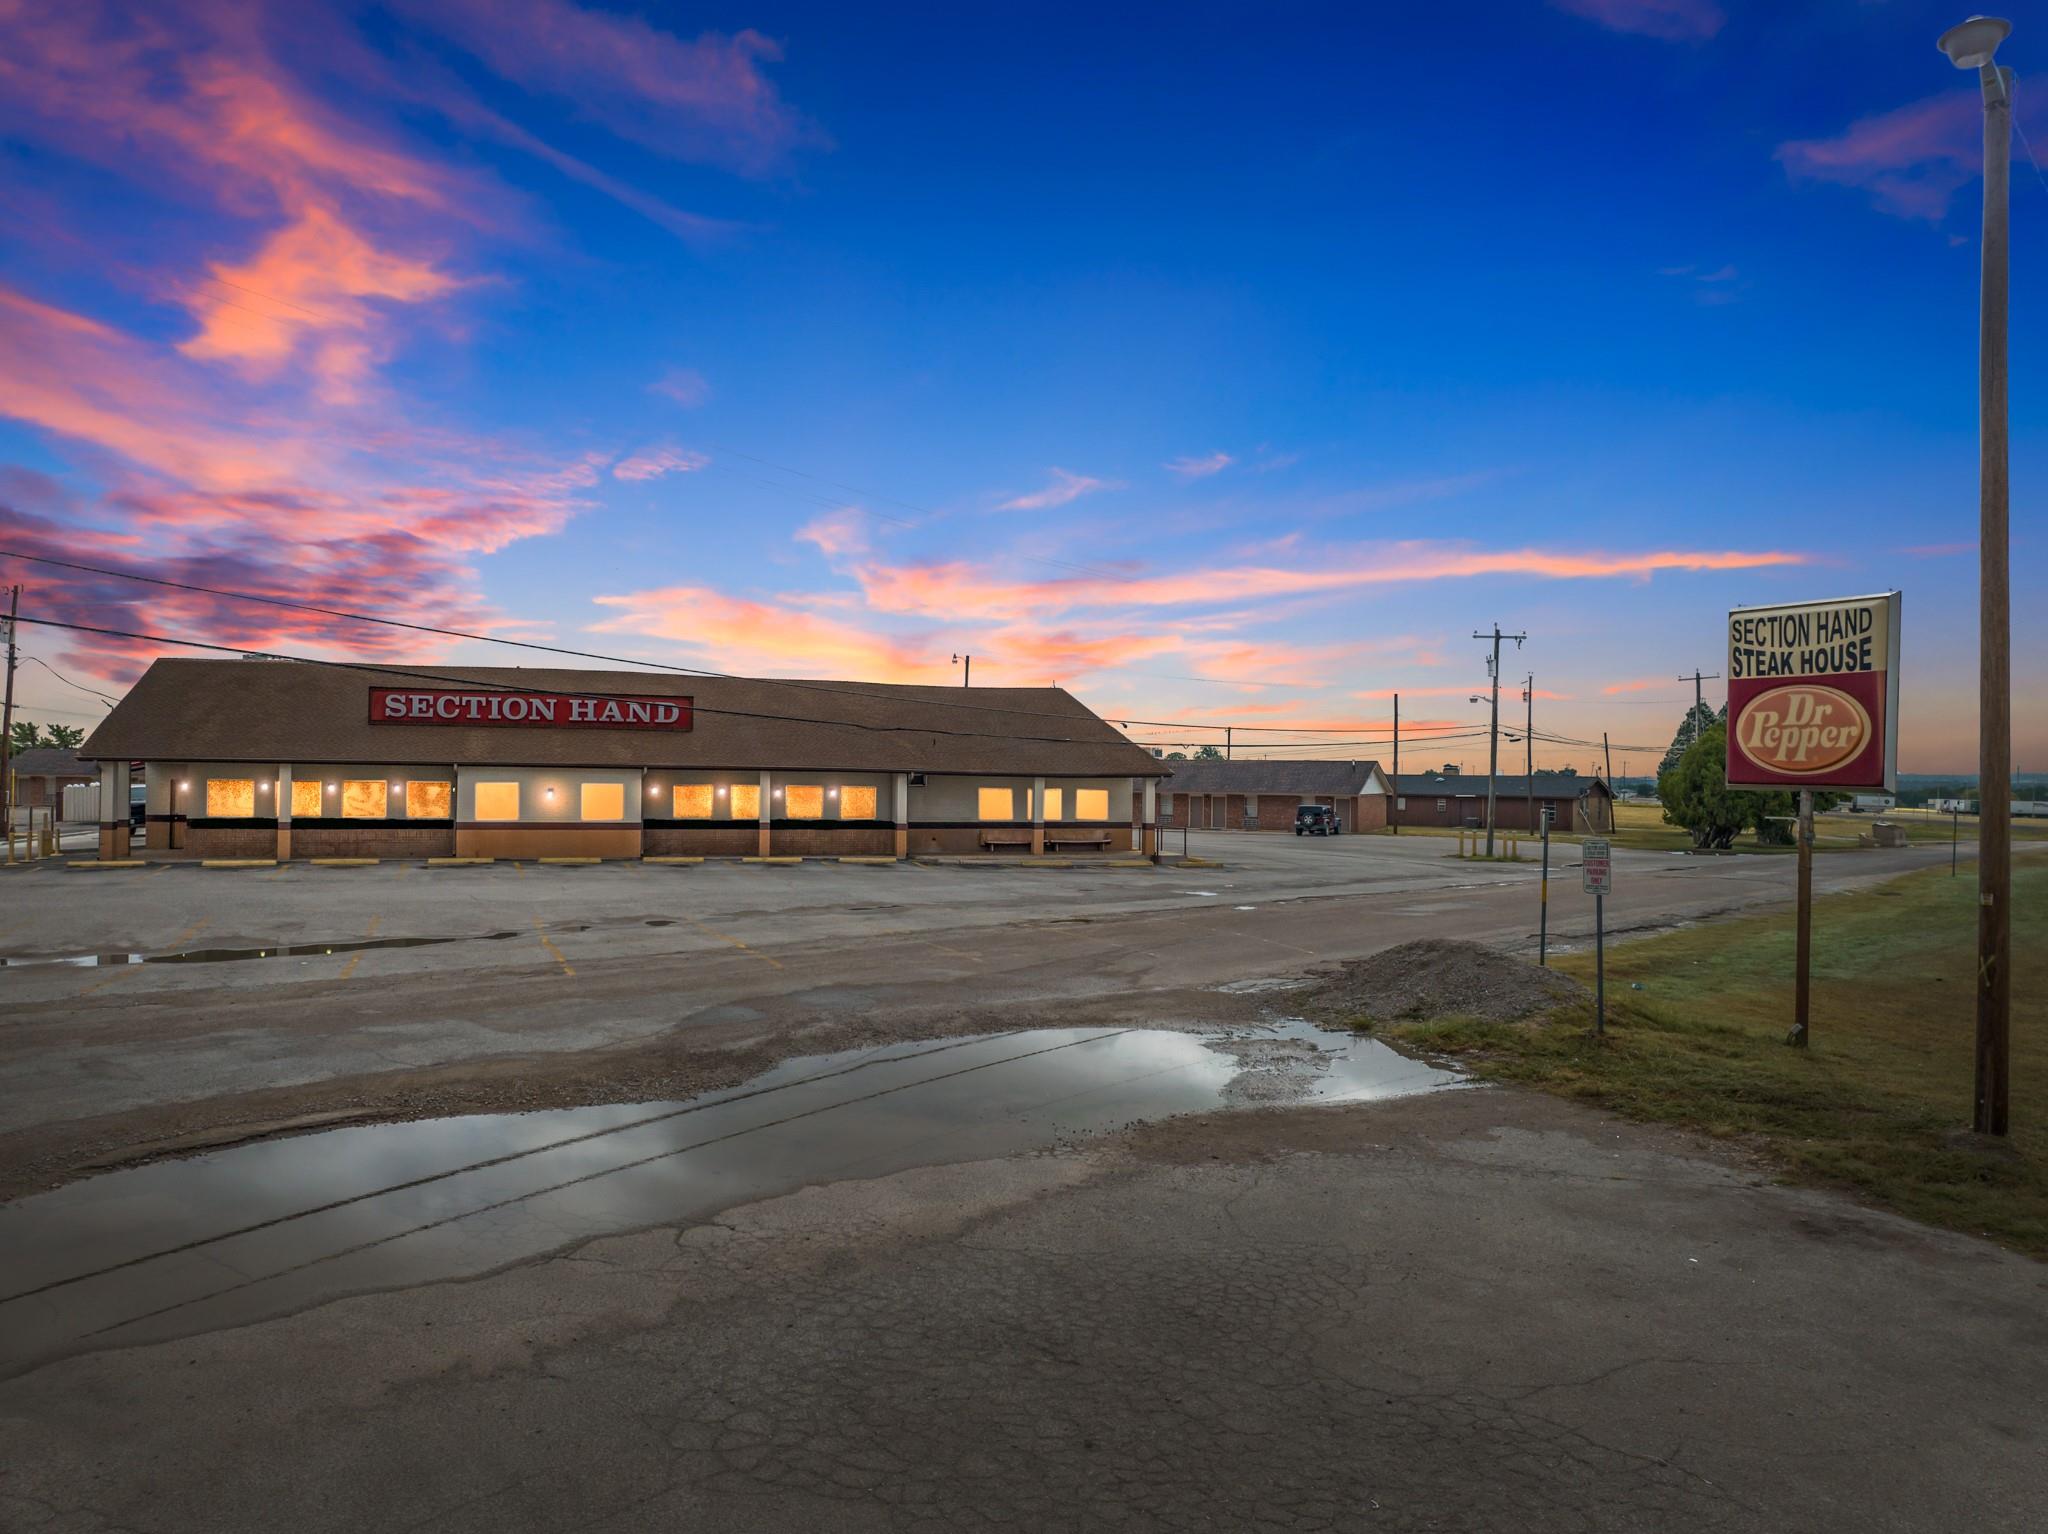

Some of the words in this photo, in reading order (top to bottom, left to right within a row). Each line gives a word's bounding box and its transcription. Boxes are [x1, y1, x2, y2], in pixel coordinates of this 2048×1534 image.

[1732, 615, 1810, 648] SECTION
[1817, 607, 1873, 643] HAND
[1732, 646, 1794, 678] STEAK
[1801, 636, 1873, 674] HOUSE
[385, 694, 557, 721] SECTION
[568, 699, 680, 723] HAND
[1783, 694, 1833, 726] Dr
[1747, 711, 1858, 762] Pepper
